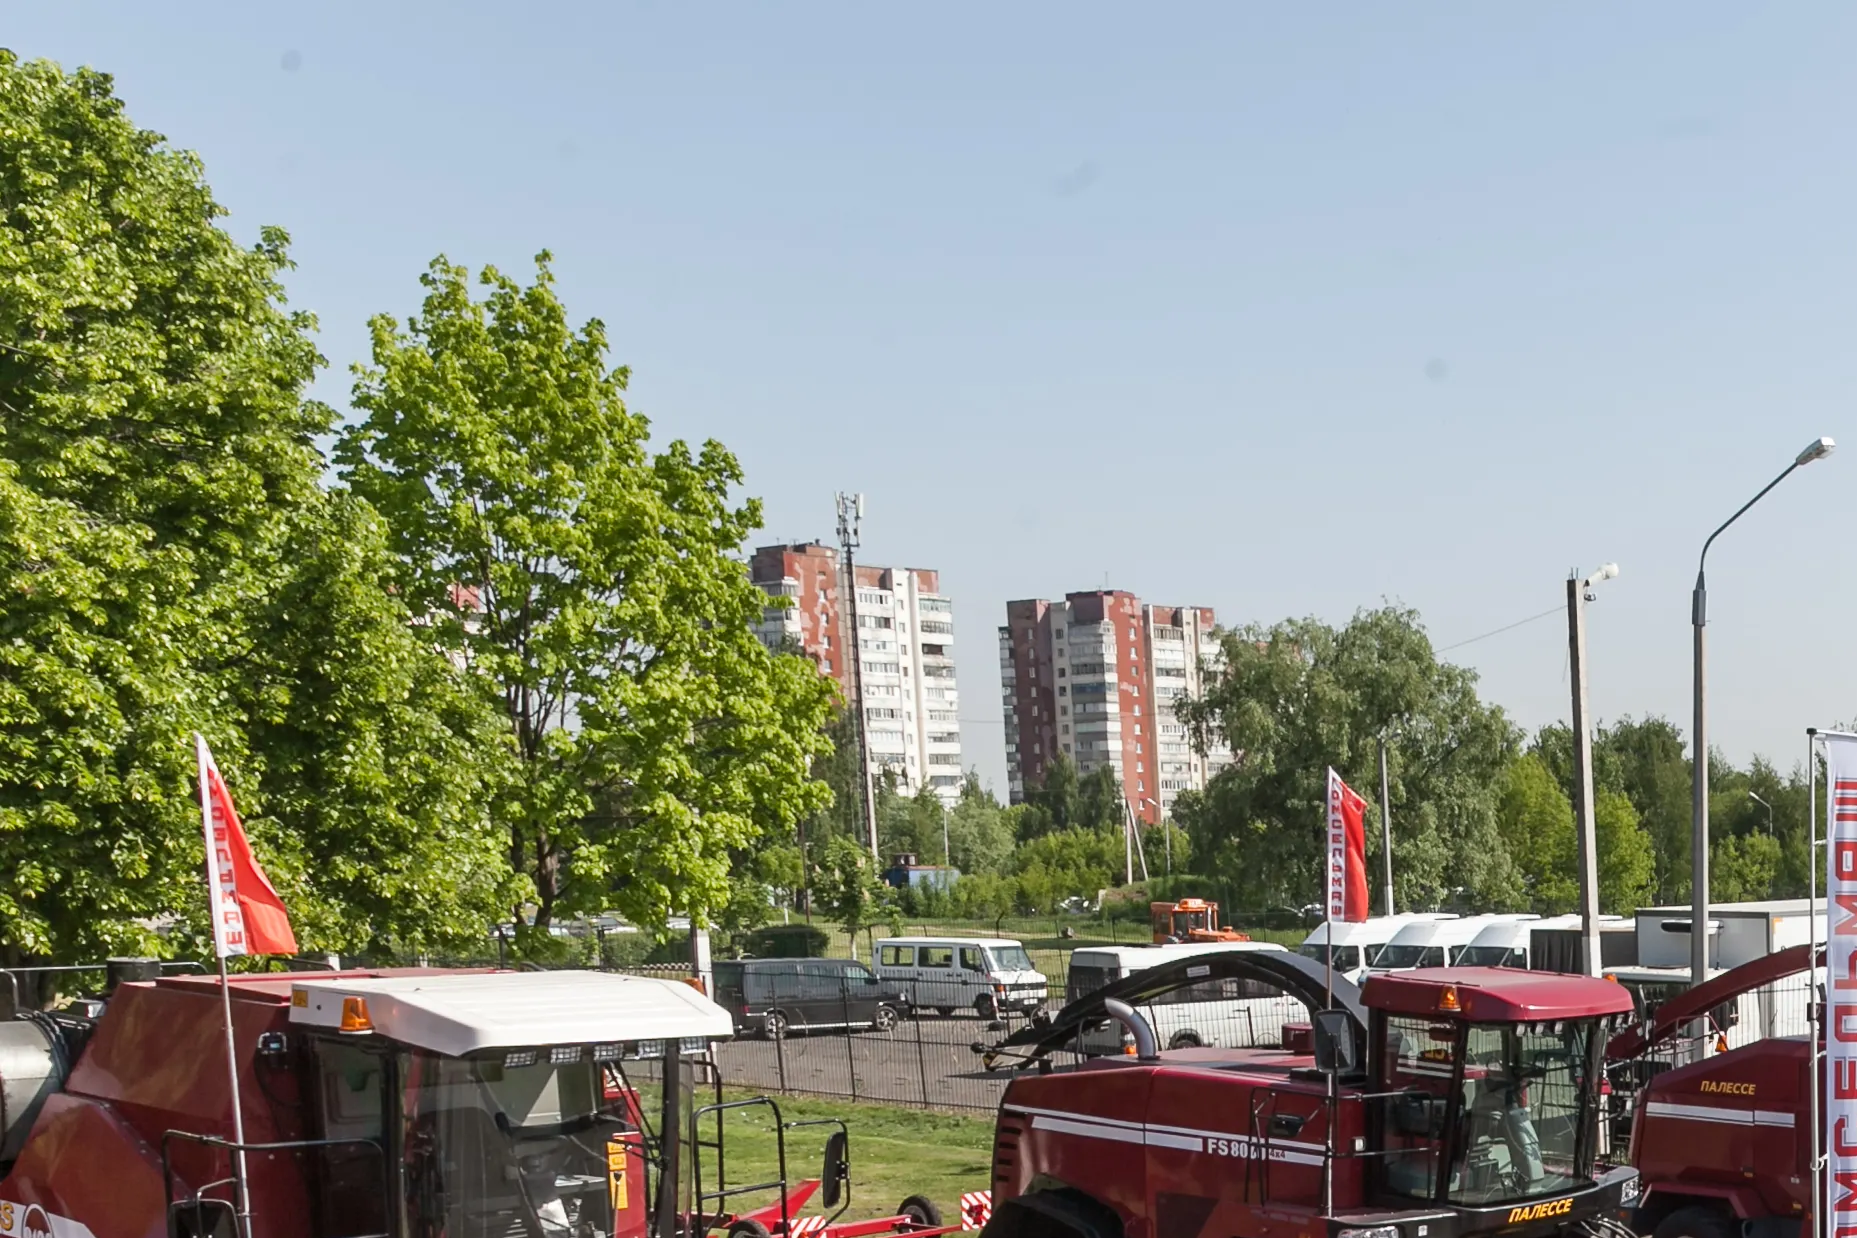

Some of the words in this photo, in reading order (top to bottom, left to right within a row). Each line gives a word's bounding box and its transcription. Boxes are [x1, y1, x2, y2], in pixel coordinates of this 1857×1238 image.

[1700, 1080, 1756, 1095] ПАЛЕССЕ
[0, 1203, 14, 1231] S
[1508, 1198, 1573, 1223] ПАЛЕССЕ
